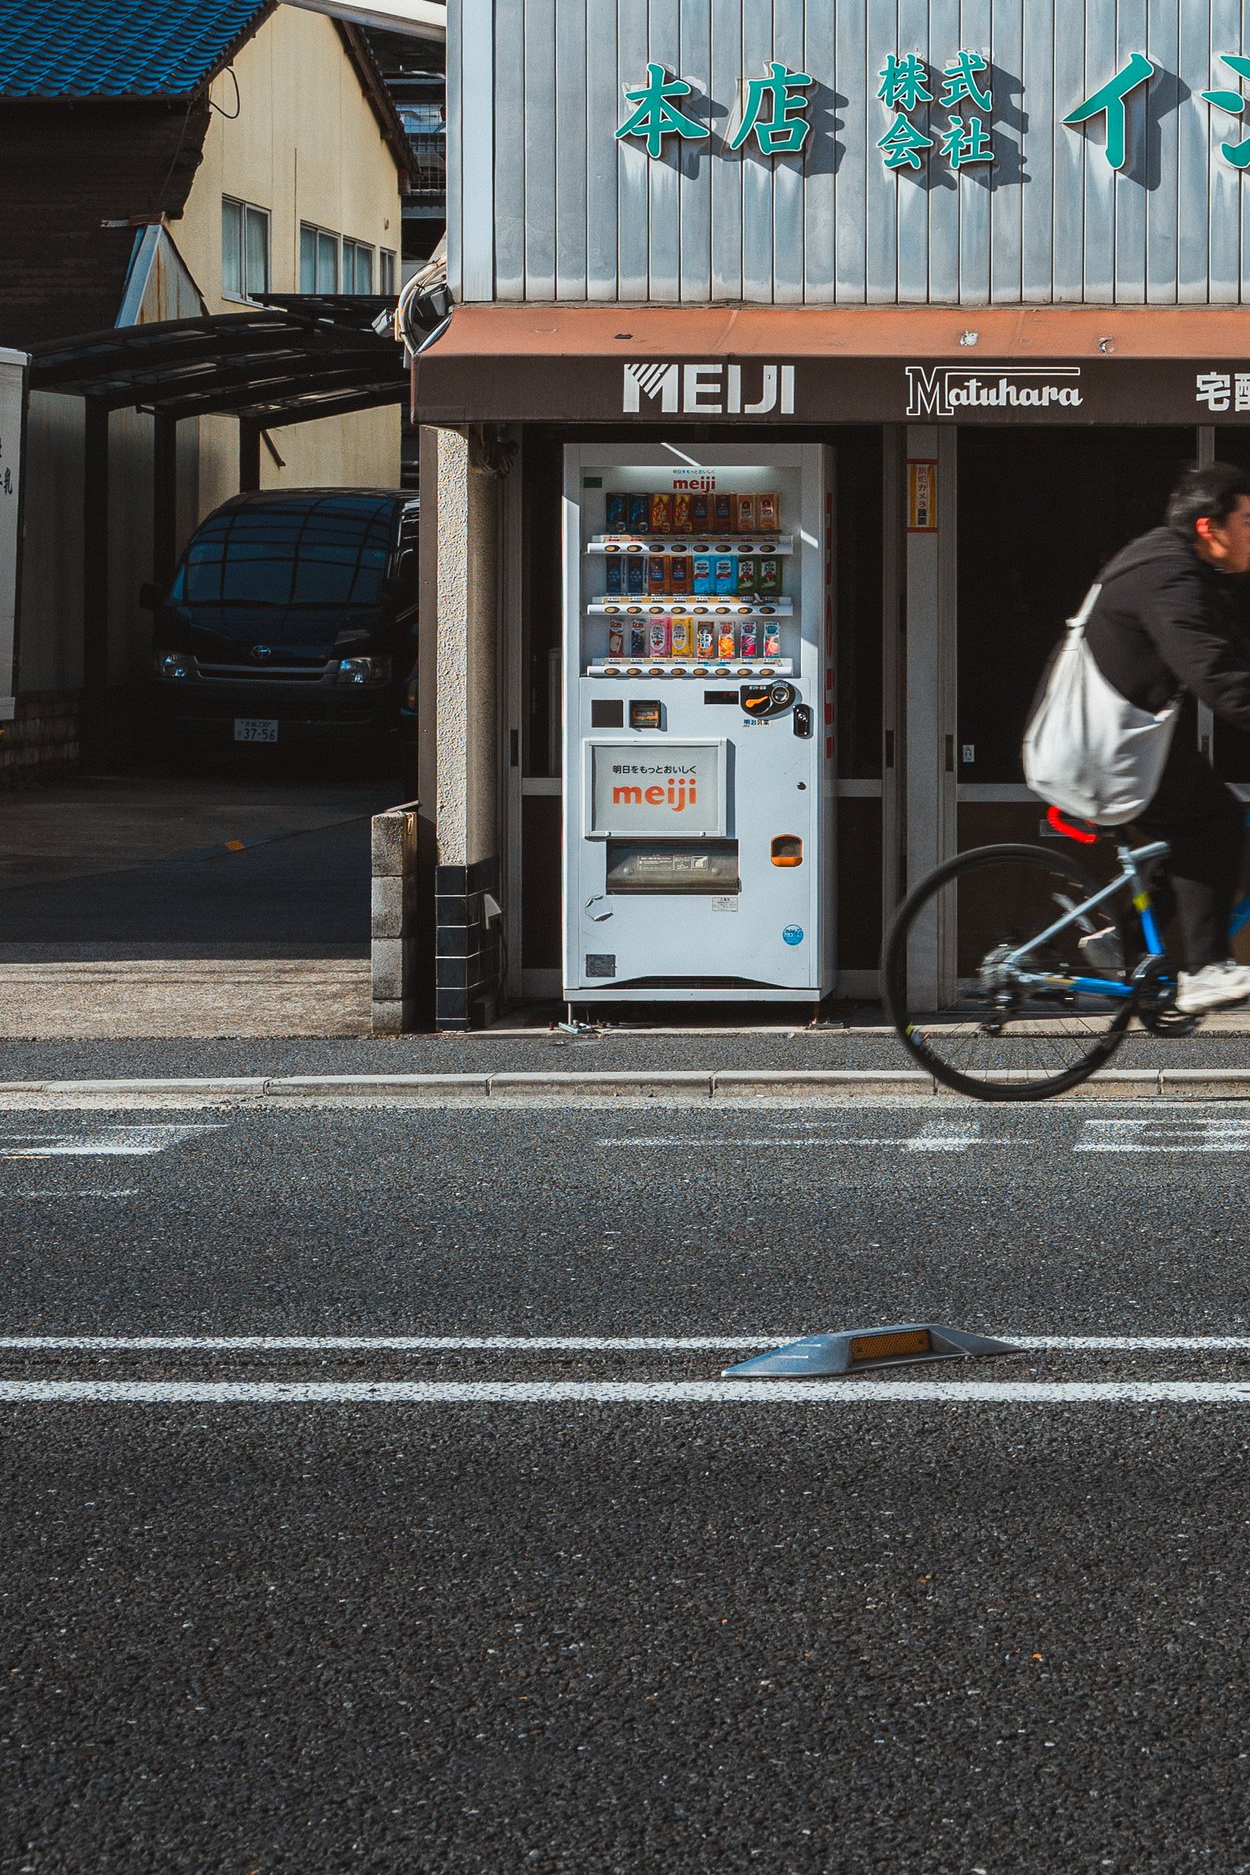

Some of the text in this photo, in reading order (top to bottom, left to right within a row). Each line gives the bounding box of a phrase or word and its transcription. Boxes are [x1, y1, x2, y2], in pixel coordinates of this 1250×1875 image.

[616, 63, 811, 157] 本店
[622, 363, 795, 415] MEIJI
[905, 365, 1084, 416] Matuhara
[672, 476, 716, 494] meiji
[243, 728, 276, 740] 37-56
[612, 764, 697, 775] 明日をもっとおいしく
[612, 778, 697, 813] meiji
